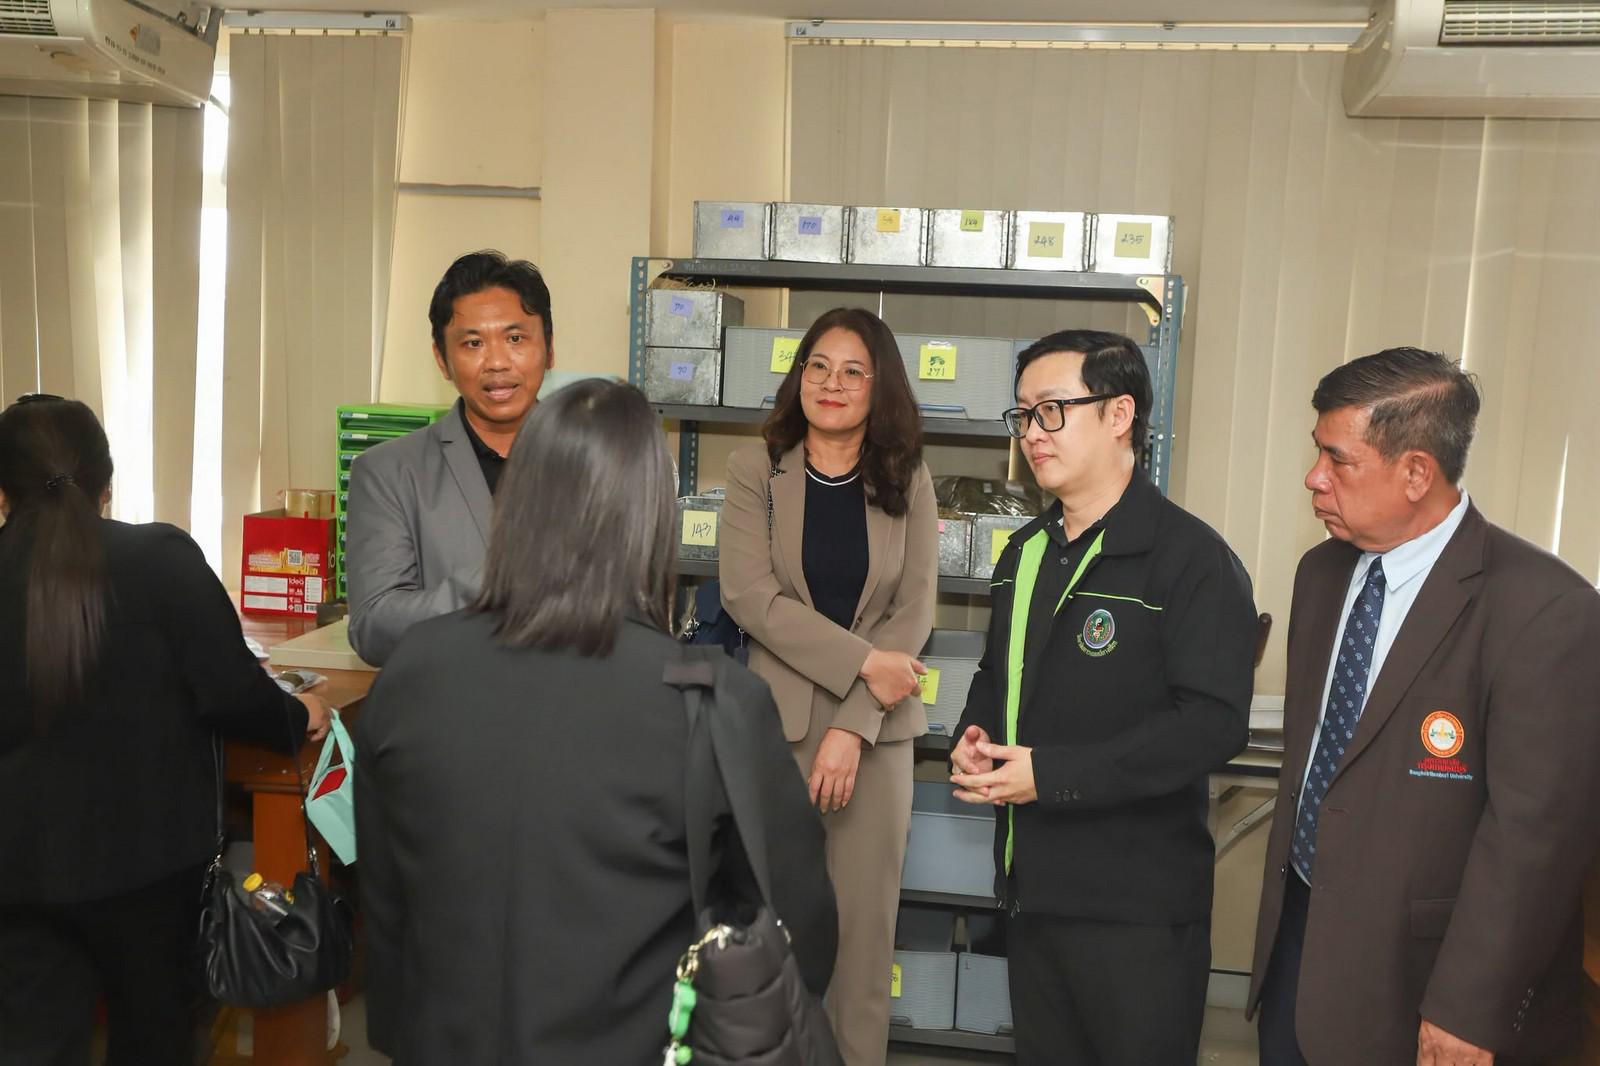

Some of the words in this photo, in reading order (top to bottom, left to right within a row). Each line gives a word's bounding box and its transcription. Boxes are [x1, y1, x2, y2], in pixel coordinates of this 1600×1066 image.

[1034, 235, 1055, 248] 248
[1121, 232, 1145, 245] 235
[927, 367, 945, 376] 271
[691, 521, 712, 538] 143
[1450, 773, 1473, 781] University
